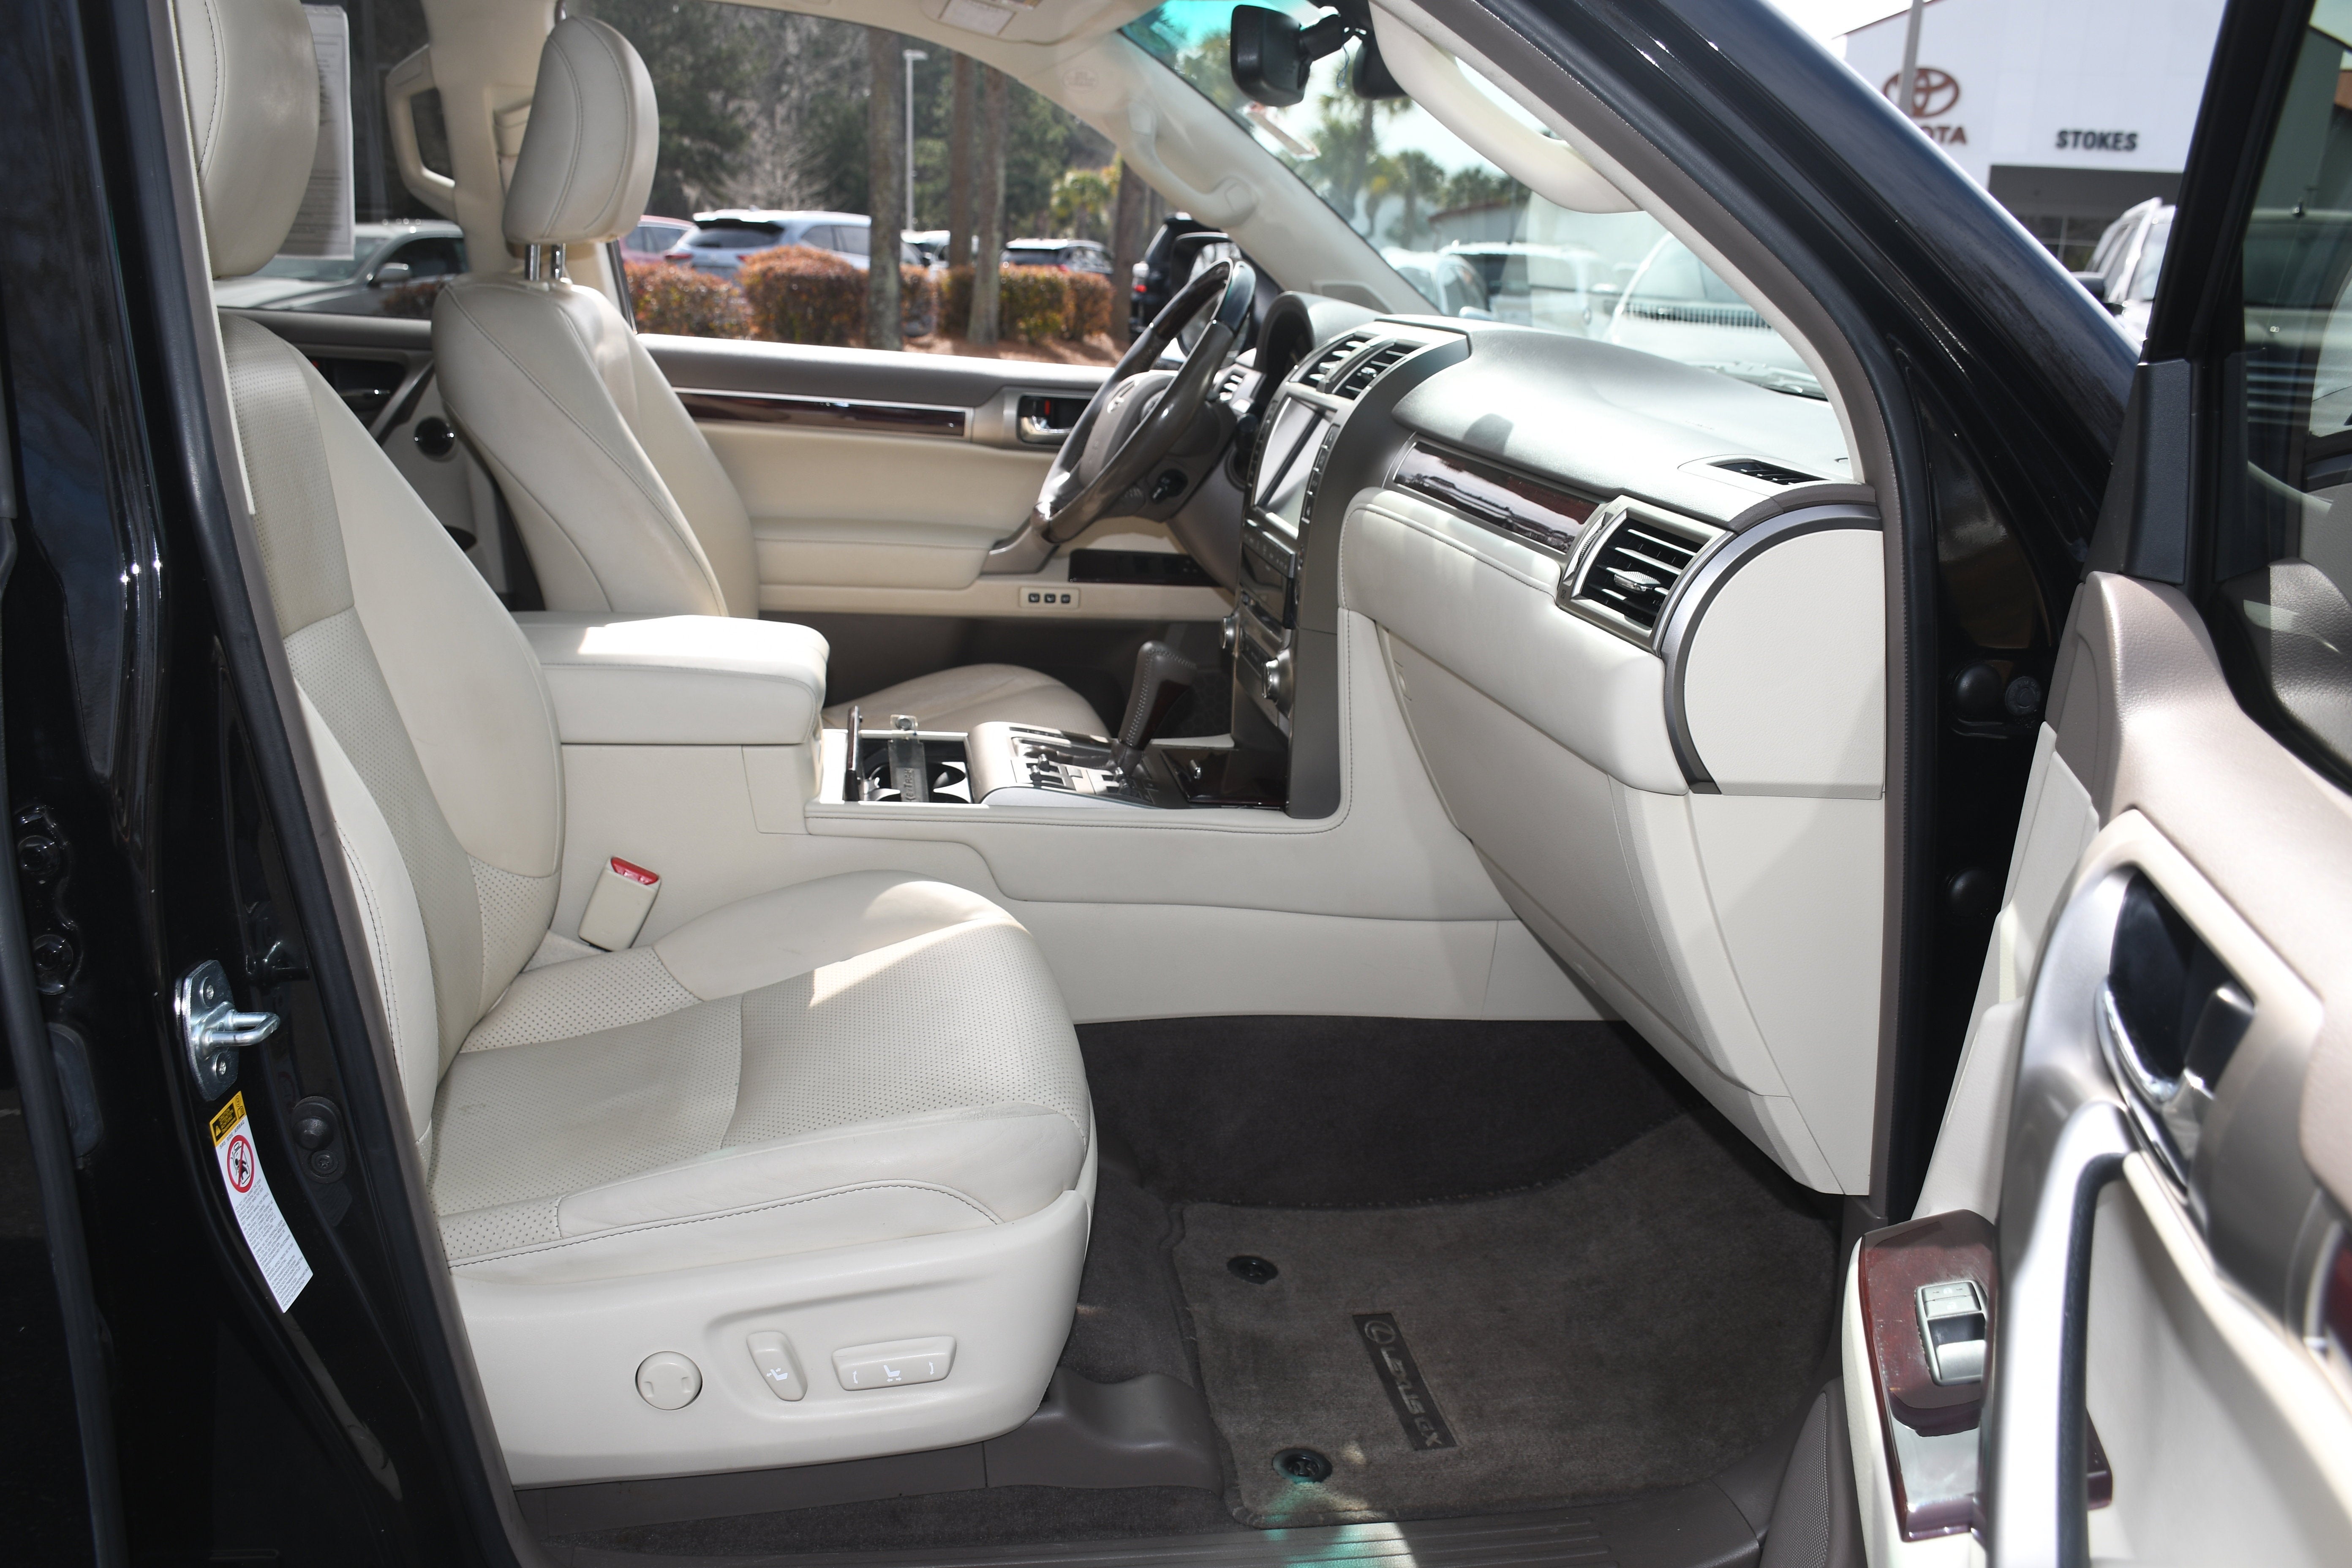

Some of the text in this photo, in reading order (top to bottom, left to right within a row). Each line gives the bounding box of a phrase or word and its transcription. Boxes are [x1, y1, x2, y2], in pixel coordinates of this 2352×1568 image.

[2055, 130, 2137, 151] STOKES
[234, 1120, 245, 1133] AIRBAG
[1380, 1347, 1443, 1447] LEXUS GX
